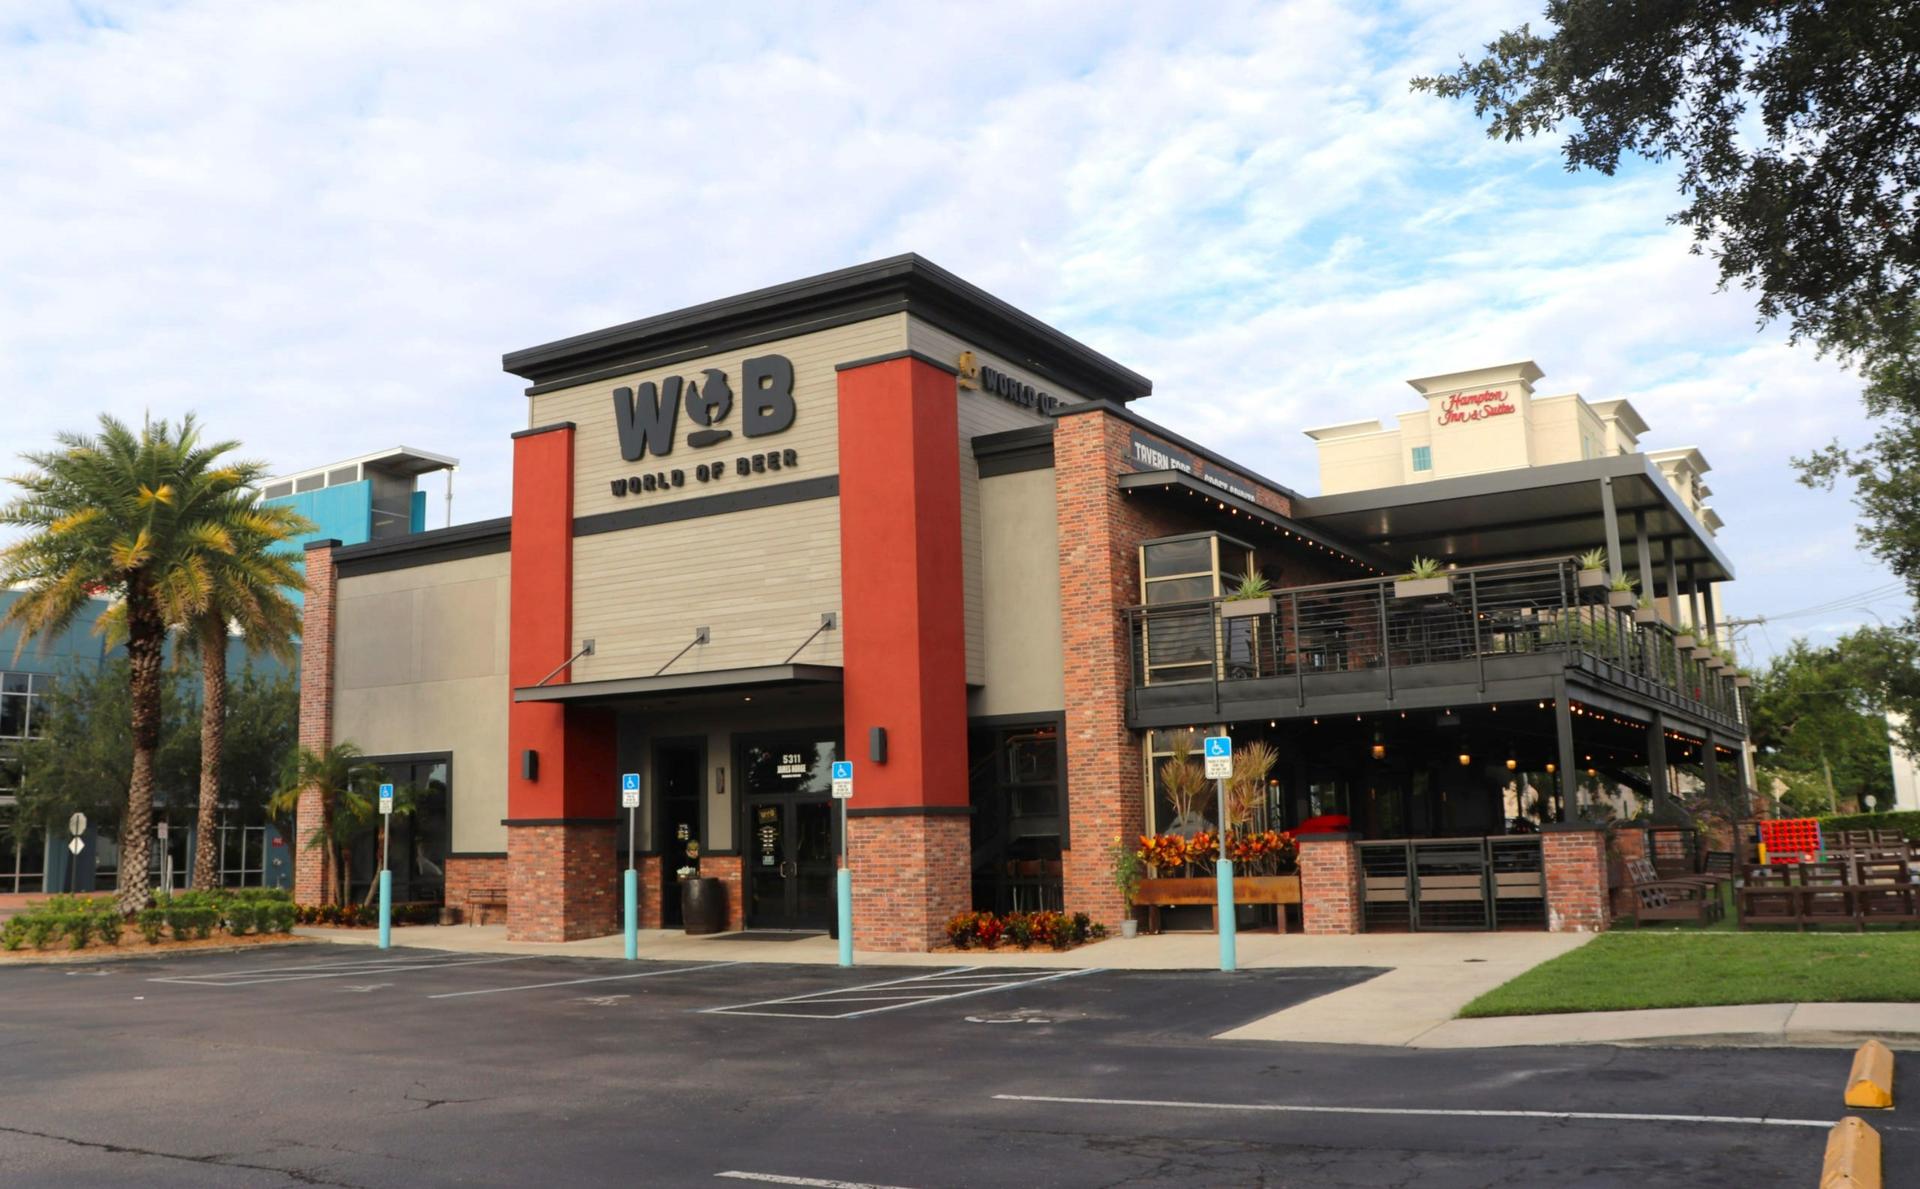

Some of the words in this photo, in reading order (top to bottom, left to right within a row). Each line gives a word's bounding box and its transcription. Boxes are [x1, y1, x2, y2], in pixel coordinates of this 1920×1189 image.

[982, 365, 1037, 409] WORLD
[1441, 390, 1508, 411] Hampton
[1438, 410, 1470, 426] Inn
[1480, 403, 1516, 419] Suites
[1134, 441, 1170, 470] TAVERN
[610, 469, 685, 497] WORLD
[696, 461, 725, 482] OF
[736, 448, 798, 476] BEER
